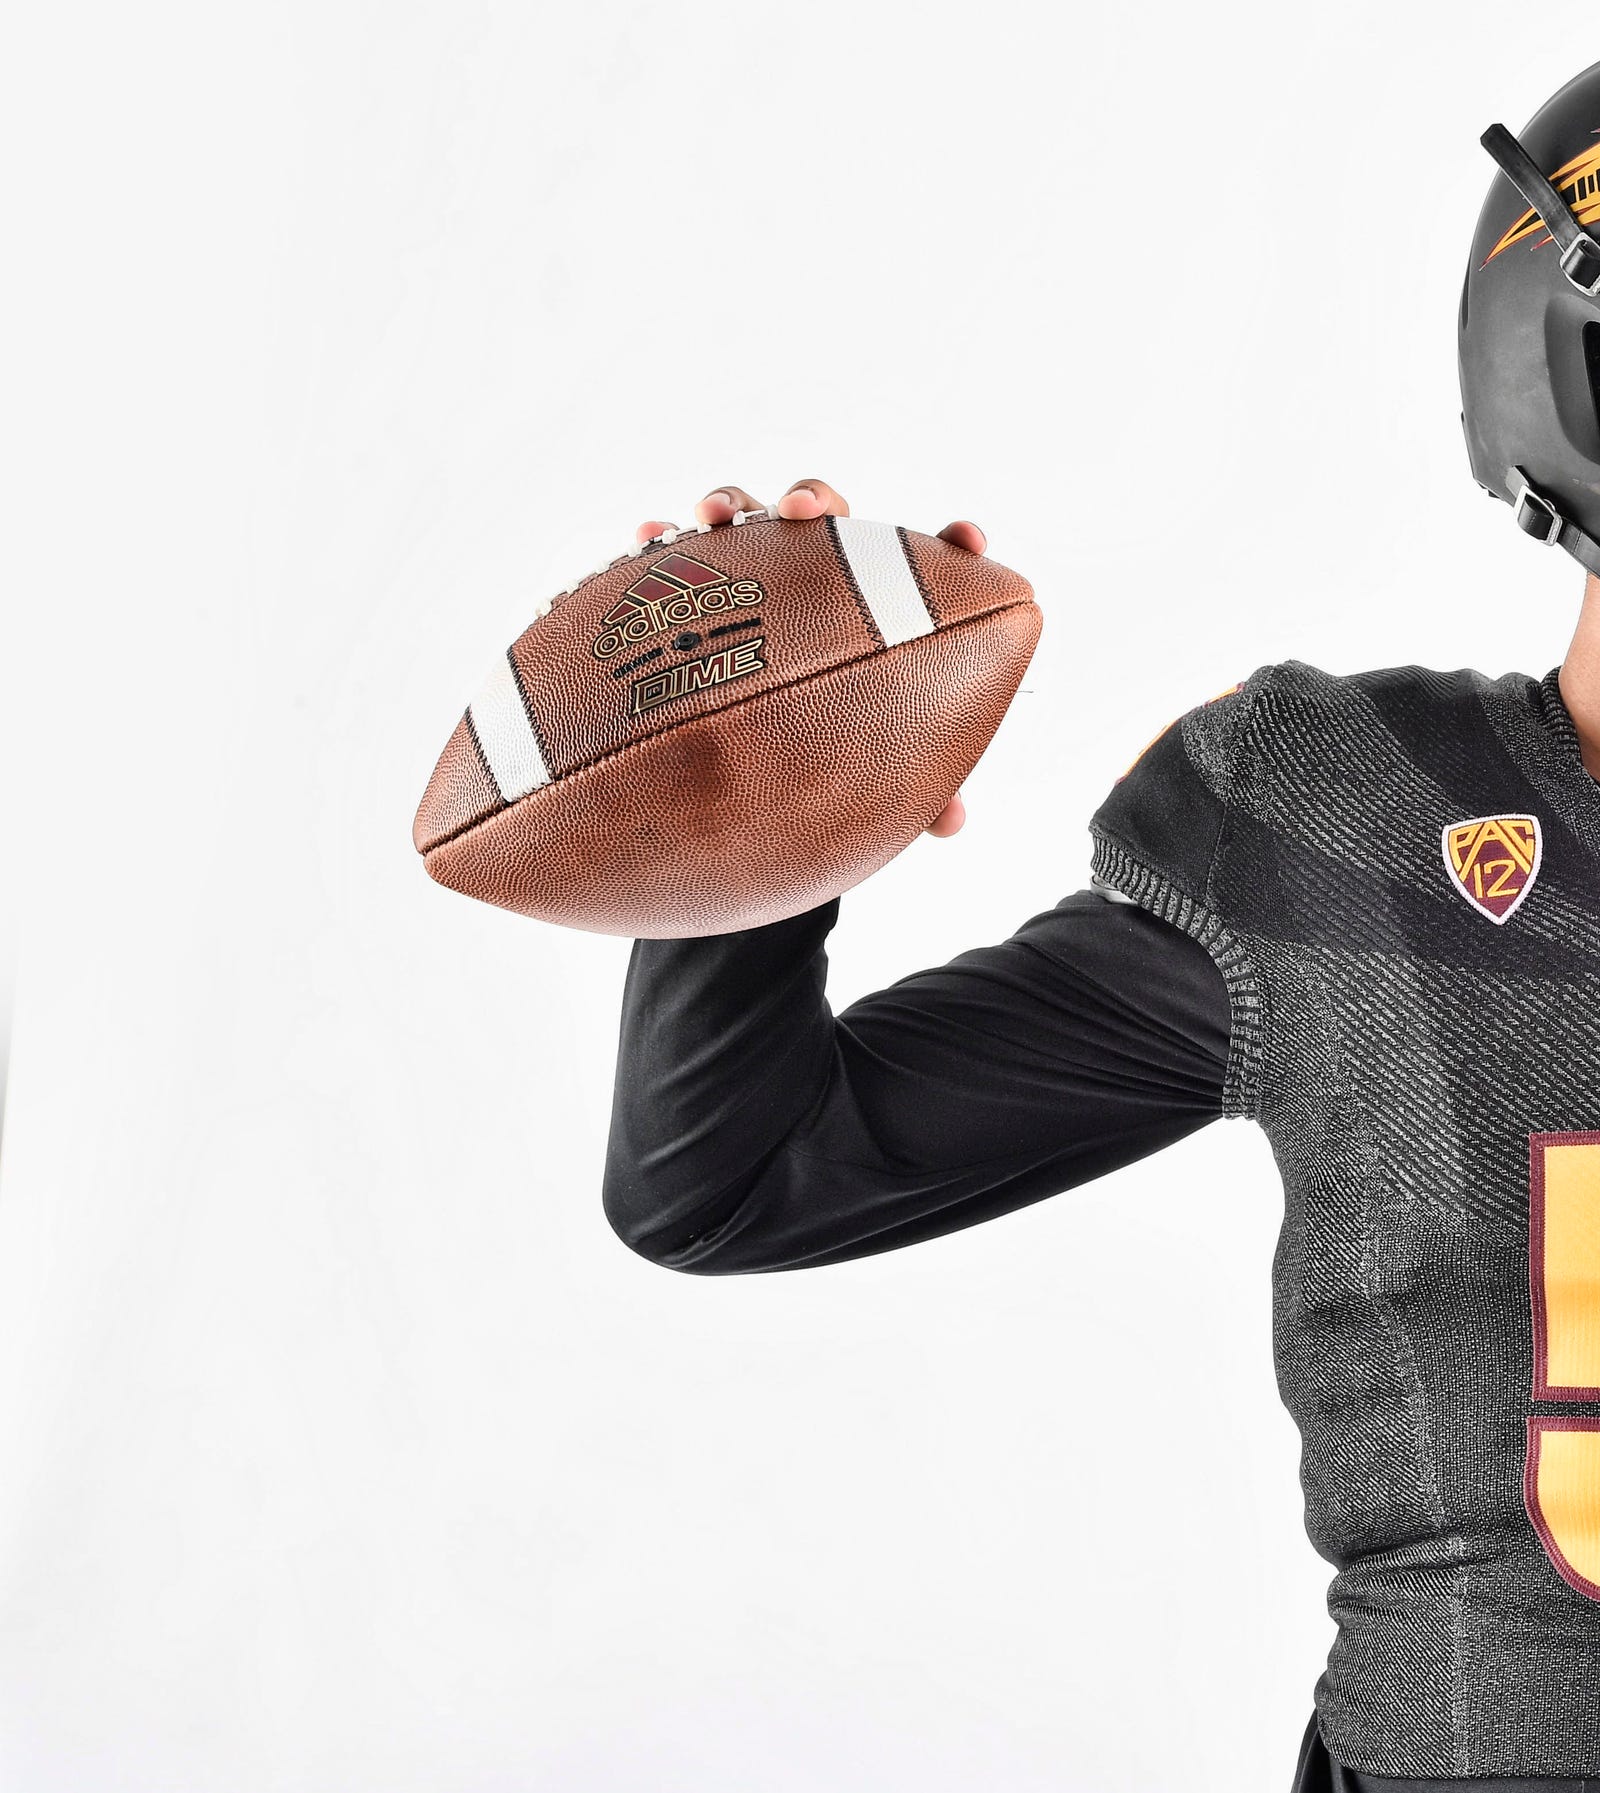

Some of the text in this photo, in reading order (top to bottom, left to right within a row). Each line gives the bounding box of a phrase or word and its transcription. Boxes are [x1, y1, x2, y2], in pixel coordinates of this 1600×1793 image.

[593, 579, 764, 660] adidas
[632, 637, 765, 715] DIME
[1447, 820, 1536, 883] PAC
[1473, 859, 1520, 899] 12
